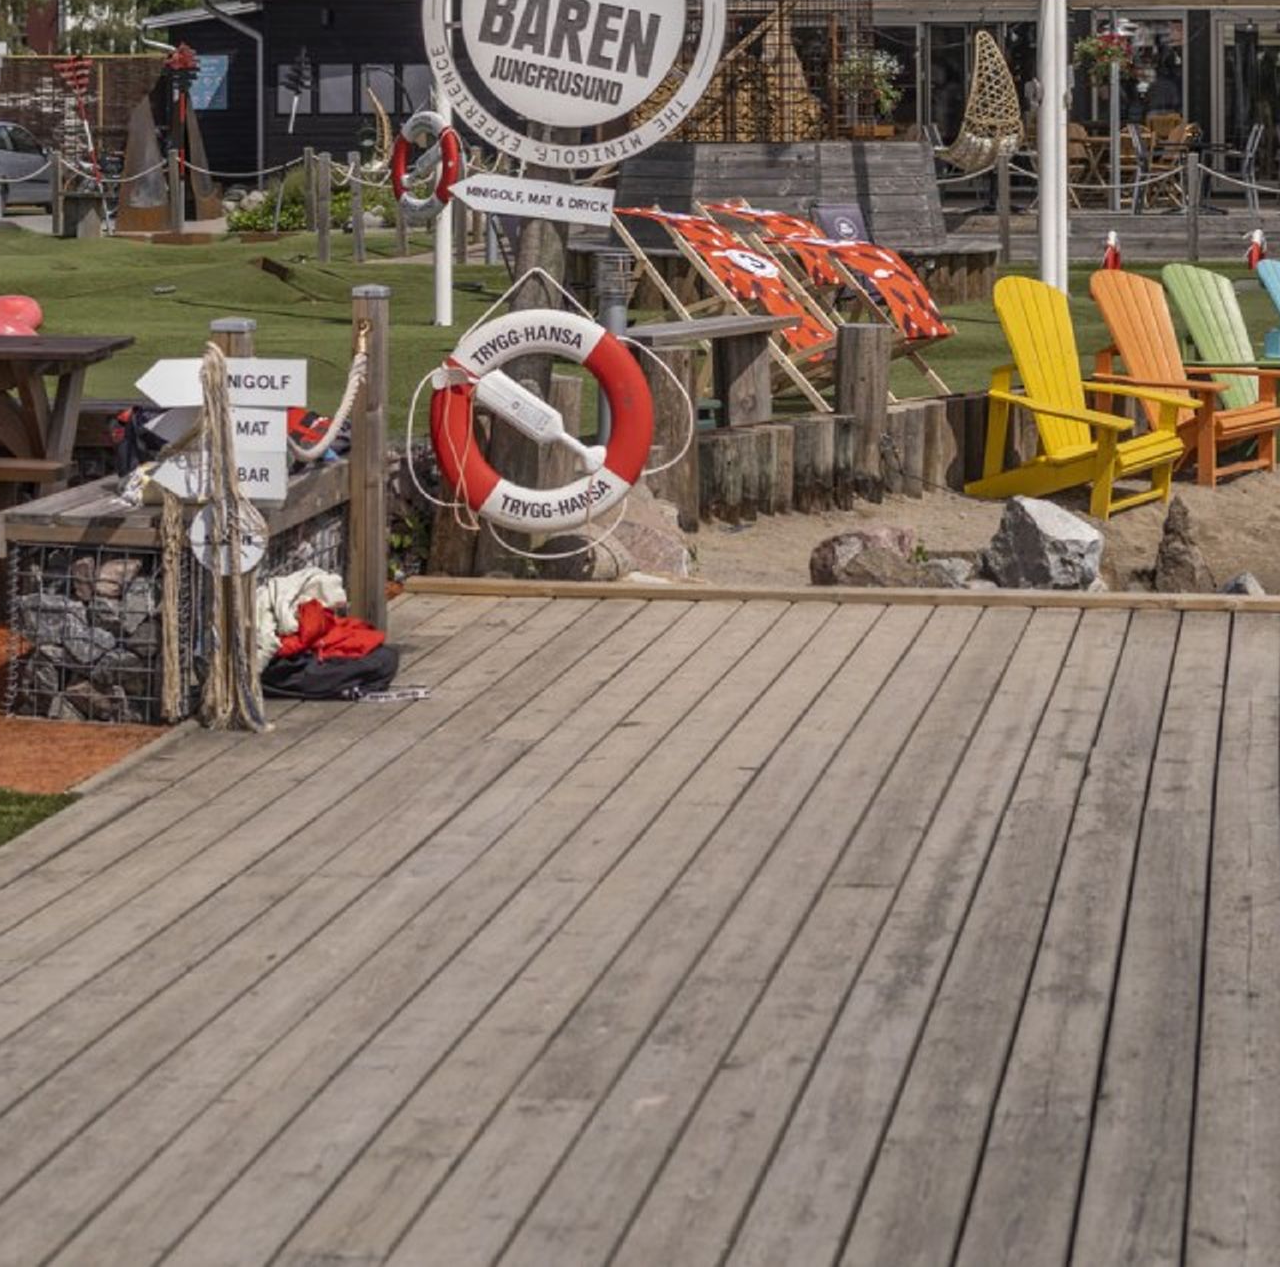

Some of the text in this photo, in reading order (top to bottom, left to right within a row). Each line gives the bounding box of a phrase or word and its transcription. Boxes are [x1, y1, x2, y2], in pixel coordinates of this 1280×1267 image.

[431, 44, 521, 152] EXPERIENCE
[490, 55, 624, 107] JUNGFRUSUND
[653, 99, 688, 133] THE
[528, 193, 552, 206] MAT
[556, 196, 564, 208] &
[568, 198, 609, 213] DRYCK
[470, 324, 584, 367] TRYGG-HANSA
[227, 374, 291, 390] NIGOLF
[236, 421, 269, 436] MAT
[237, 468, 270, 483] BAR
[501, 479, 612, 519] TRYGG-HANSA
